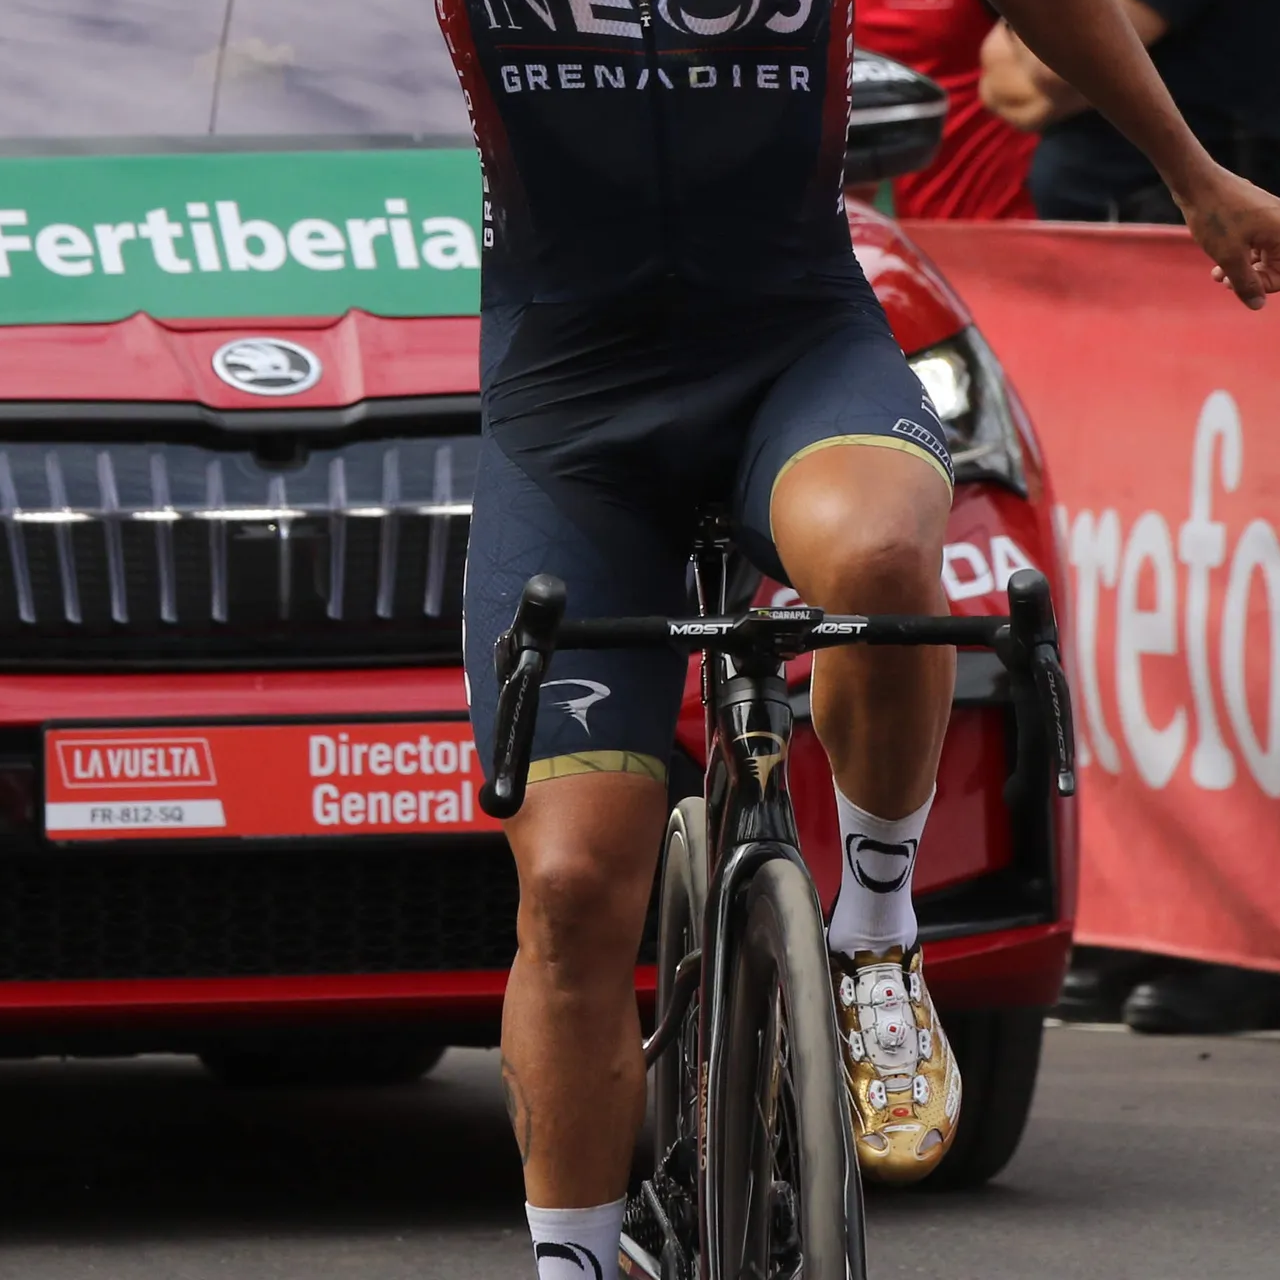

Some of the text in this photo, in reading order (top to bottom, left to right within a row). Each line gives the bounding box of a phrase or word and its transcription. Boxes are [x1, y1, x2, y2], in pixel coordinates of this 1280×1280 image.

[500, 64, 811, 93] GRENADIER
[772, 610, 811, 620] CARAPAZ
[74, 747, 201, 779] LA VUELTA
[308, 734, 477, 777] Director
[312, 781, 474, 826] General
